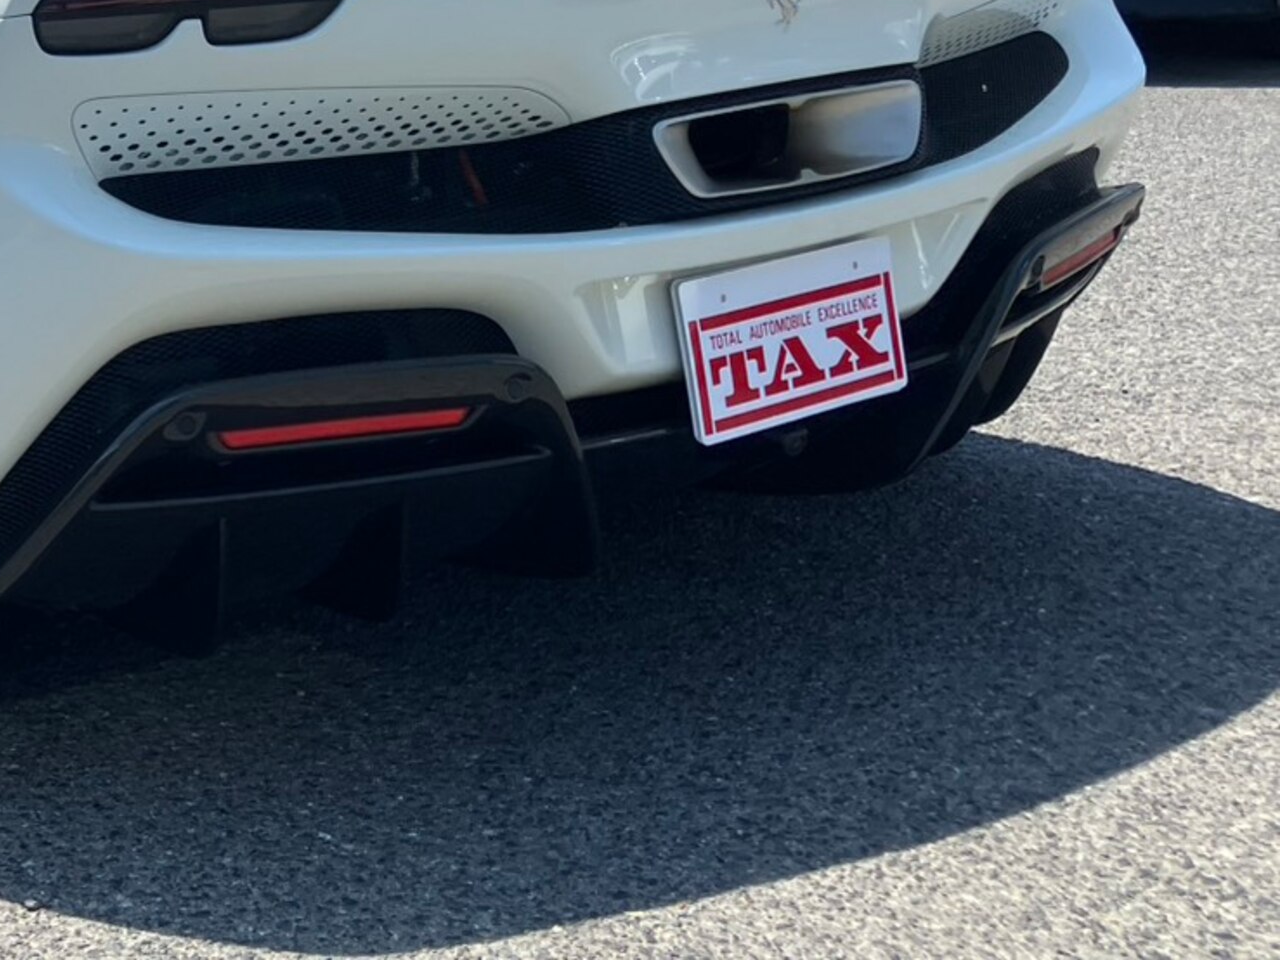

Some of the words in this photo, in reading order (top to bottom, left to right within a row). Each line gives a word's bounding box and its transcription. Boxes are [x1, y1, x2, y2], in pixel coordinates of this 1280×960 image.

[710, 329, 743, 351] TOTAL
[749, 311, 812, 339] AUTOMOBILE
[818, 293, 879, 322] EXCELLENCE
[709, 313, 890, 408] TAX
